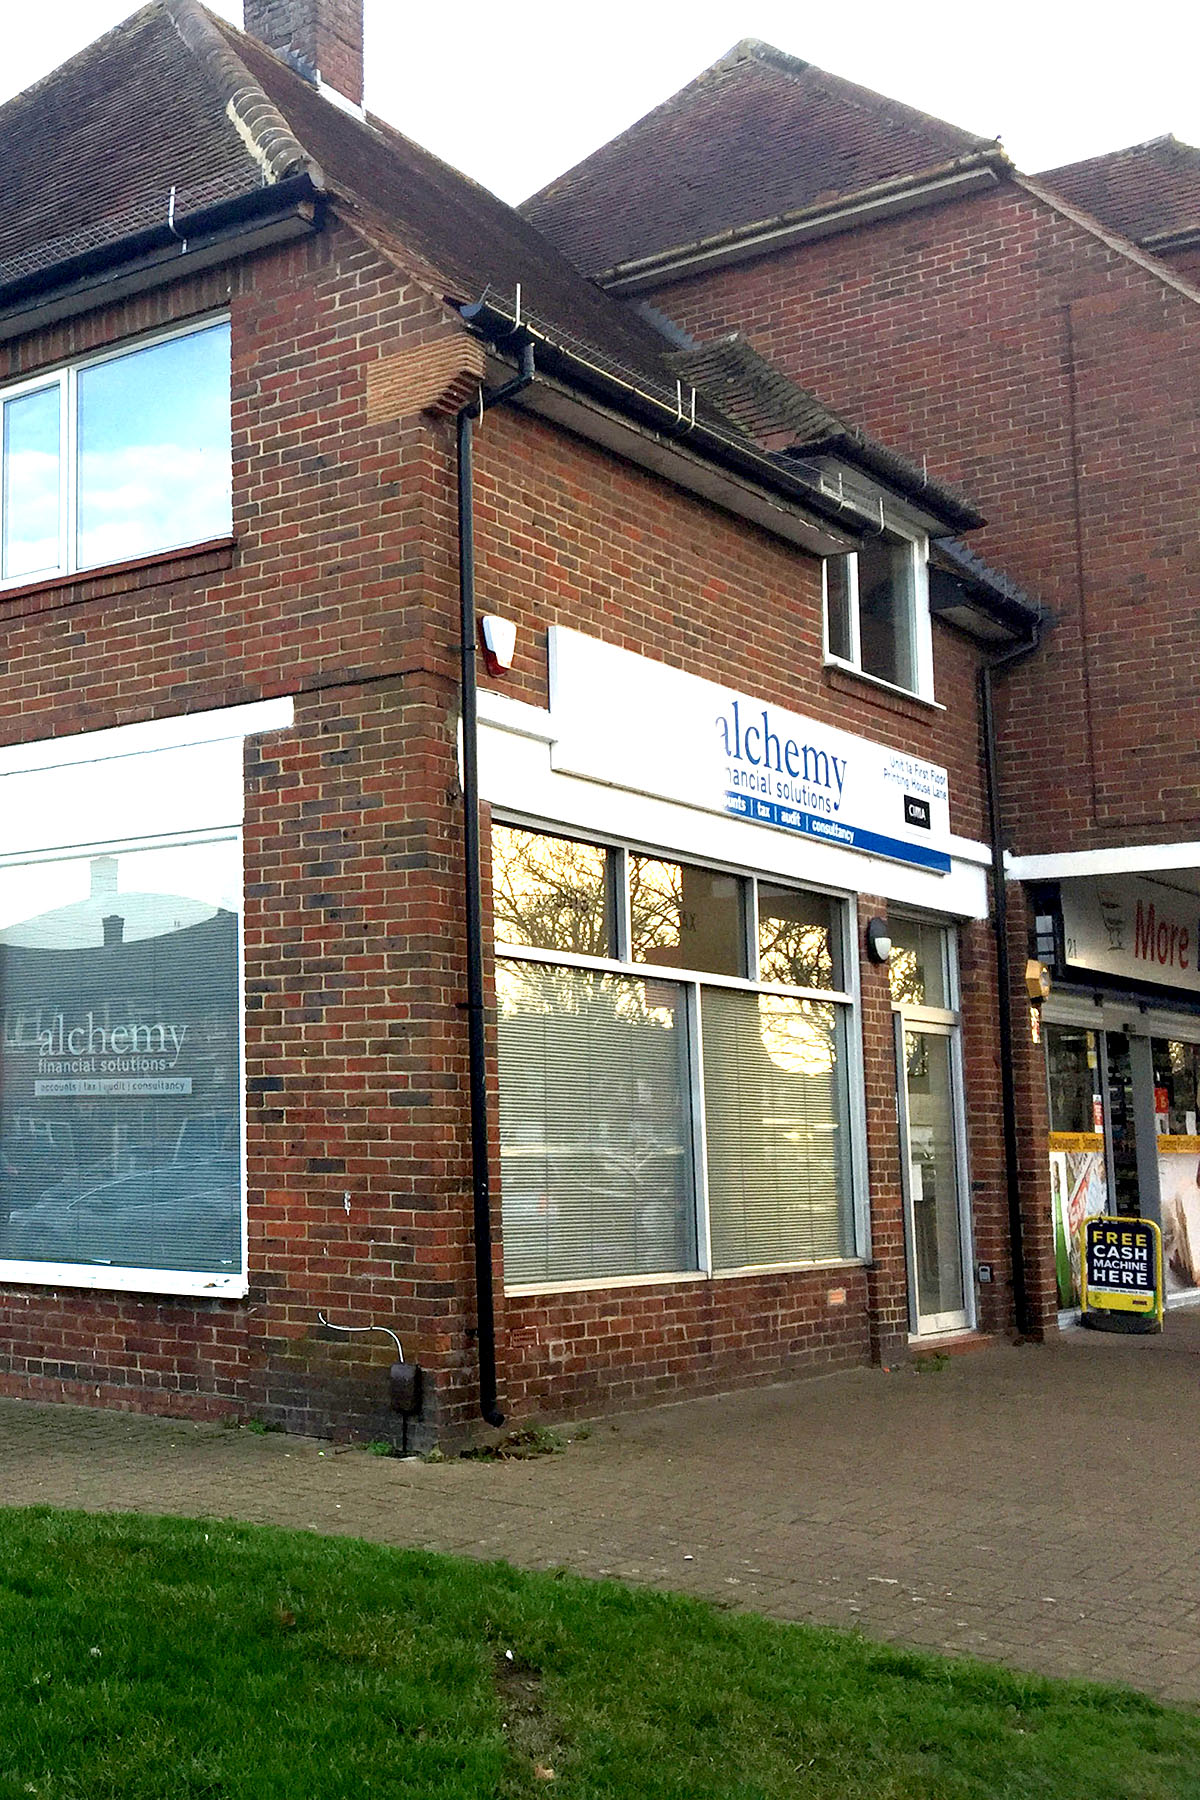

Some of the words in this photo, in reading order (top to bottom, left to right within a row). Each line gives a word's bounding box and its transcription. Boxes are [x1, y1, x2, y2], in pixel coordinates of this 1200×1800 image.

[715, 700, 847, 811] alchemy
[884, 767, 909, 790] Printing
[912, 778, 930, 795] House
[915, 764, 929, 780] First
[931, 769, 946, 785] Floor
[725, 766, 772, 795] nancial
[777, 780, 832, 813] solutions
[757, 801, 770, 818] tax
[781, 810, 801, 827] audit
[811, 819, 855, 844] consultancy
[1135, 899, 1189, 969] More
[38, 1011, 189, 1068] alchemy
[38, 1057, 96, 1074] financial
[100, 1056, 166, 1073] solutions
[41, 1082, 76, 1092] accounts
[83, 1081, 96, 1091] tax
[132, 1080, 185, 1092] consultancy
[1092, 1230, 1147, 1247] FREE
[1093, 1244, 1147, 1261] CASH
[1093, 1258, 1147, 1271] MACHINE
[1093, 1270, 1147, 1286] HERE
